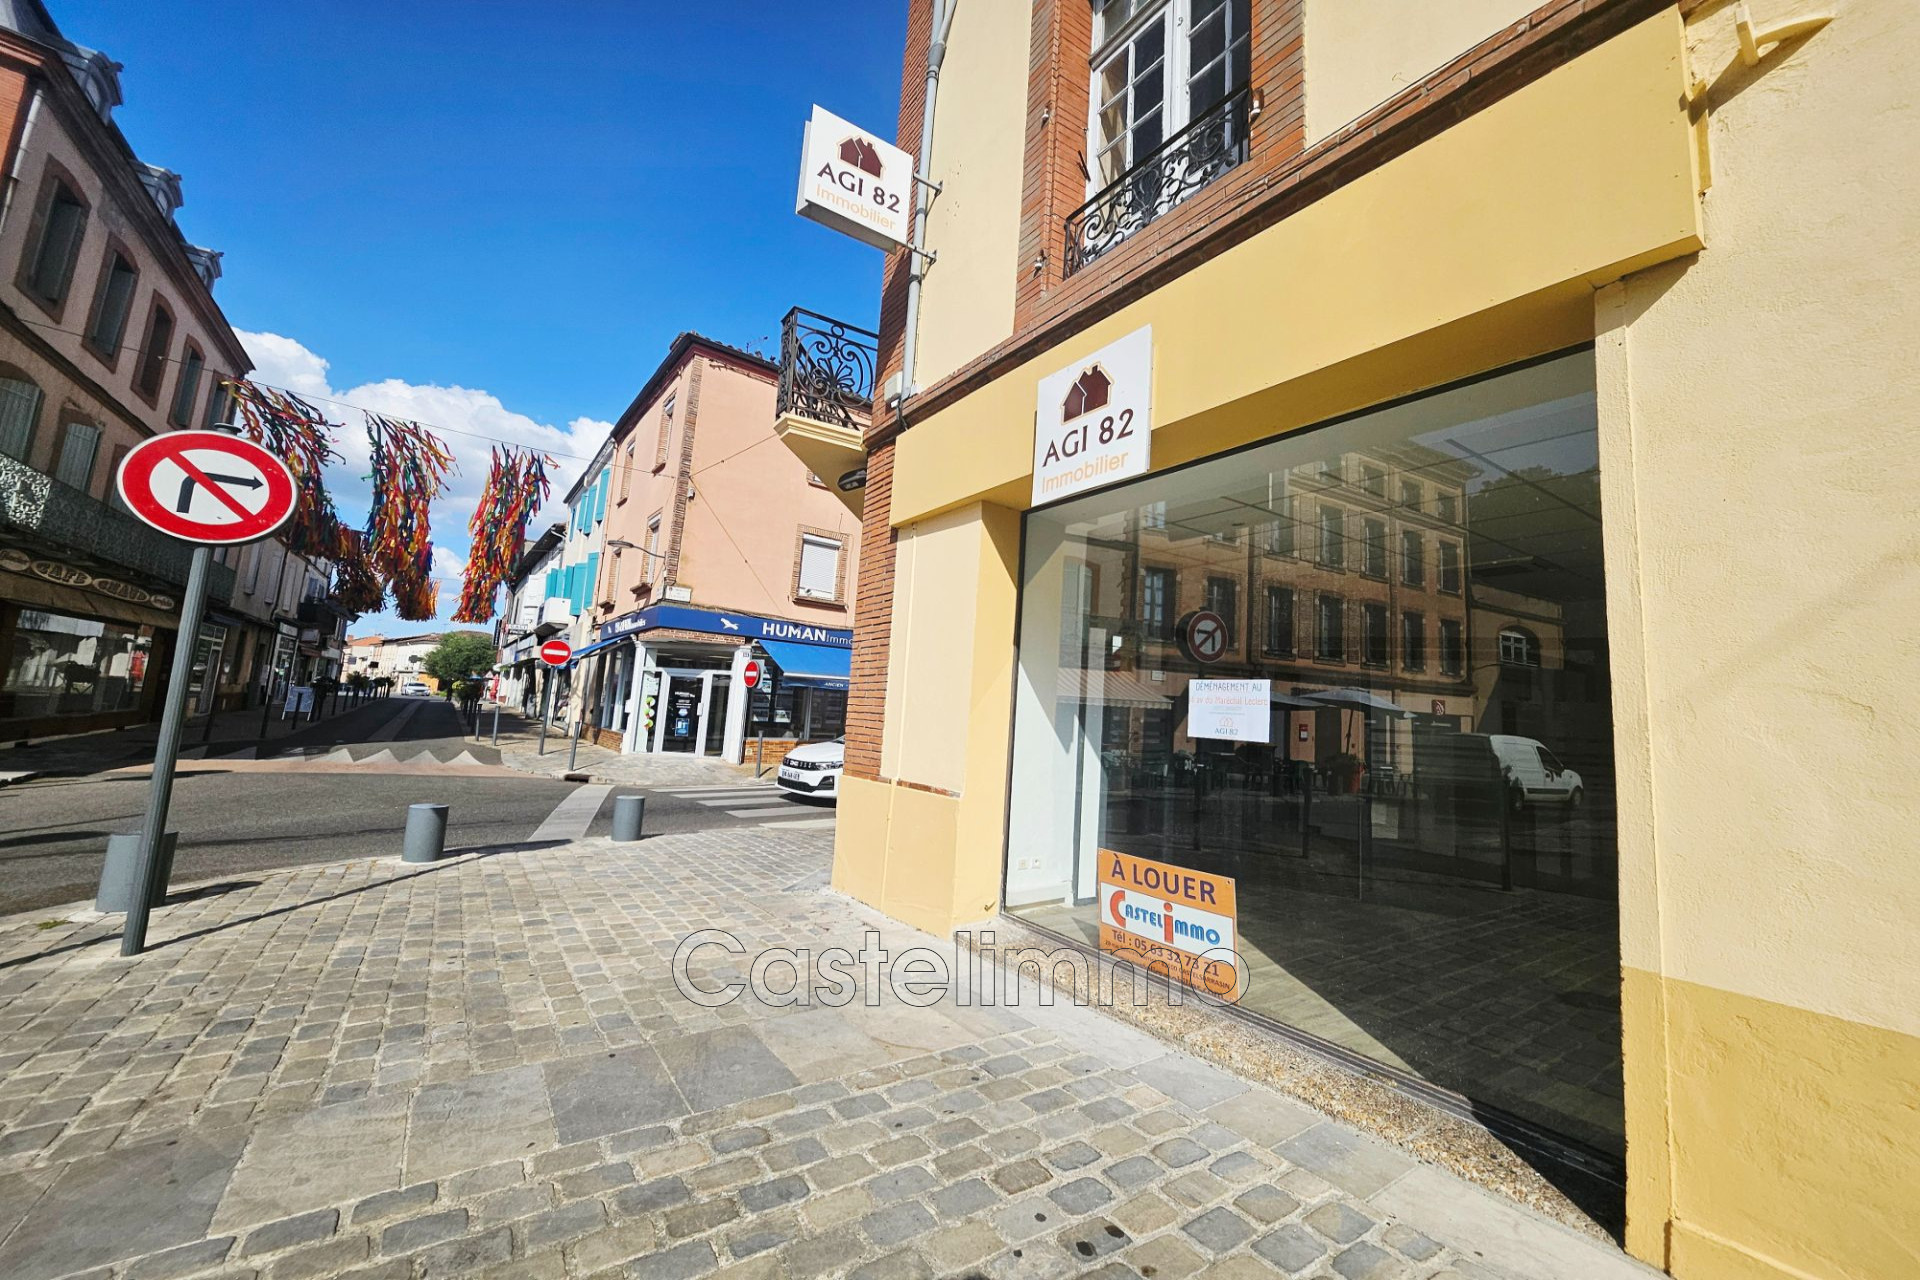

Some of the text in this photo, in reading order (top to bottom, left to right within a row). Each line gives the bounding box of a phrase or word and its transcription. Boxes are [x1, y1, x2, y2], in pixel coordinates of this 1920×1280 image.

[816, 184, 897, 230] Immobilier
[817, 162, 900, 214] AGI 82
[1042, 408, 1134, 468] AGI 82
[1042, 452, 1129, 494] Immobilier
[762, 622, 827, 642] HUMAN
[1195, 681, 1263, 693] DÉMÉNAGEMENT AU
[1111, 853, 1217, 905] À LOUER
[1112, 929, 1126, 944] Tél
[1134, 938, 1147, 951] 05
[1150, 944, 1164, 957] 63
[1205, 963, 1220, 977] 21
